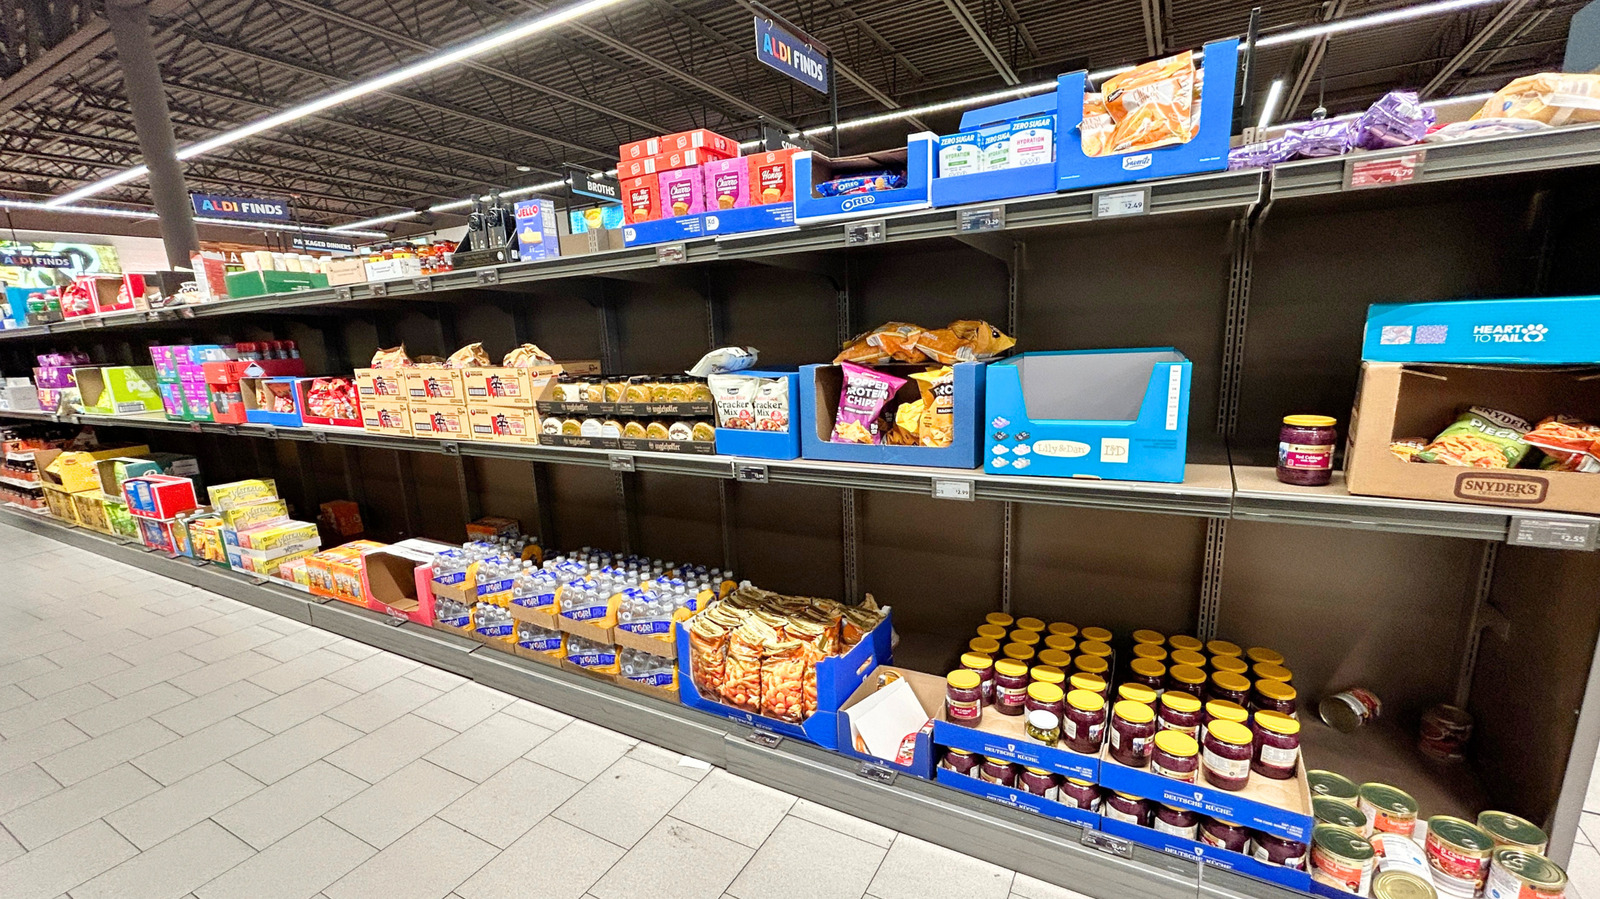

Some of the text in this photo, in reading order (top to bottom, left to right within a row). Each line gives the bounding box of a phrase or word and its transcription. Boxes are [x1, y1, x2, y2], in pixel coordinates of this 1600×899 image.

[763, 33, 824, 82] ALDI FINDS
[1012, 118, 1051, 131] ZERO SUGAR
[940, 134, 975, 146] ZERO SUGAR
[985, 132, 1010, 145] ZERO SUGA
[1016, 137, 1045, 145] HYDRATION
[1124, 156, 1151, 168] Savoritz
[717, 178, 738, 187] Churro
[762, 170, 783, 183] Honey
[587, 180, 615, 197] BROTHS
[671, 186, 691, 195] Churro
[838, 181, 859, 191] OREO
[202, 199, 283, 216] ALDI FINDS
[841, 195, 875, 212] OREO
[1125, 202, 1143, 210] $2.49
[293, 238, 352, 251] PAKAGED DINNERS
[4, 256, 70, 266] ALDI FINDS
[1473, 325, 1523, 334] HEART
[1473, 334, 1523, 343] TO TAIL
[847, 376, 889, 391] POPPED
[717, 400, 749, 409] Cracker
[847, 395, 877, 408] CHIPS
[1470, 418, 1526, 445] PIECES
[1464, 480, 1538, 495] SNYDER'S
[1561, 535, 1585, 543] $2.55
[485, 581, 502, 592] propel
[572, 608, 591, 620] propel
[631, 622, 653, 633] propel
[528, 640, 547, 651] propel
[579, 655, 599, 666] propel
[984, 746, 1016, 758] DEUTSCHE
[1163, 792, 1203, 808] DEUTSCHE
[1164, 846, 1203, 861] DEUTSCHE
